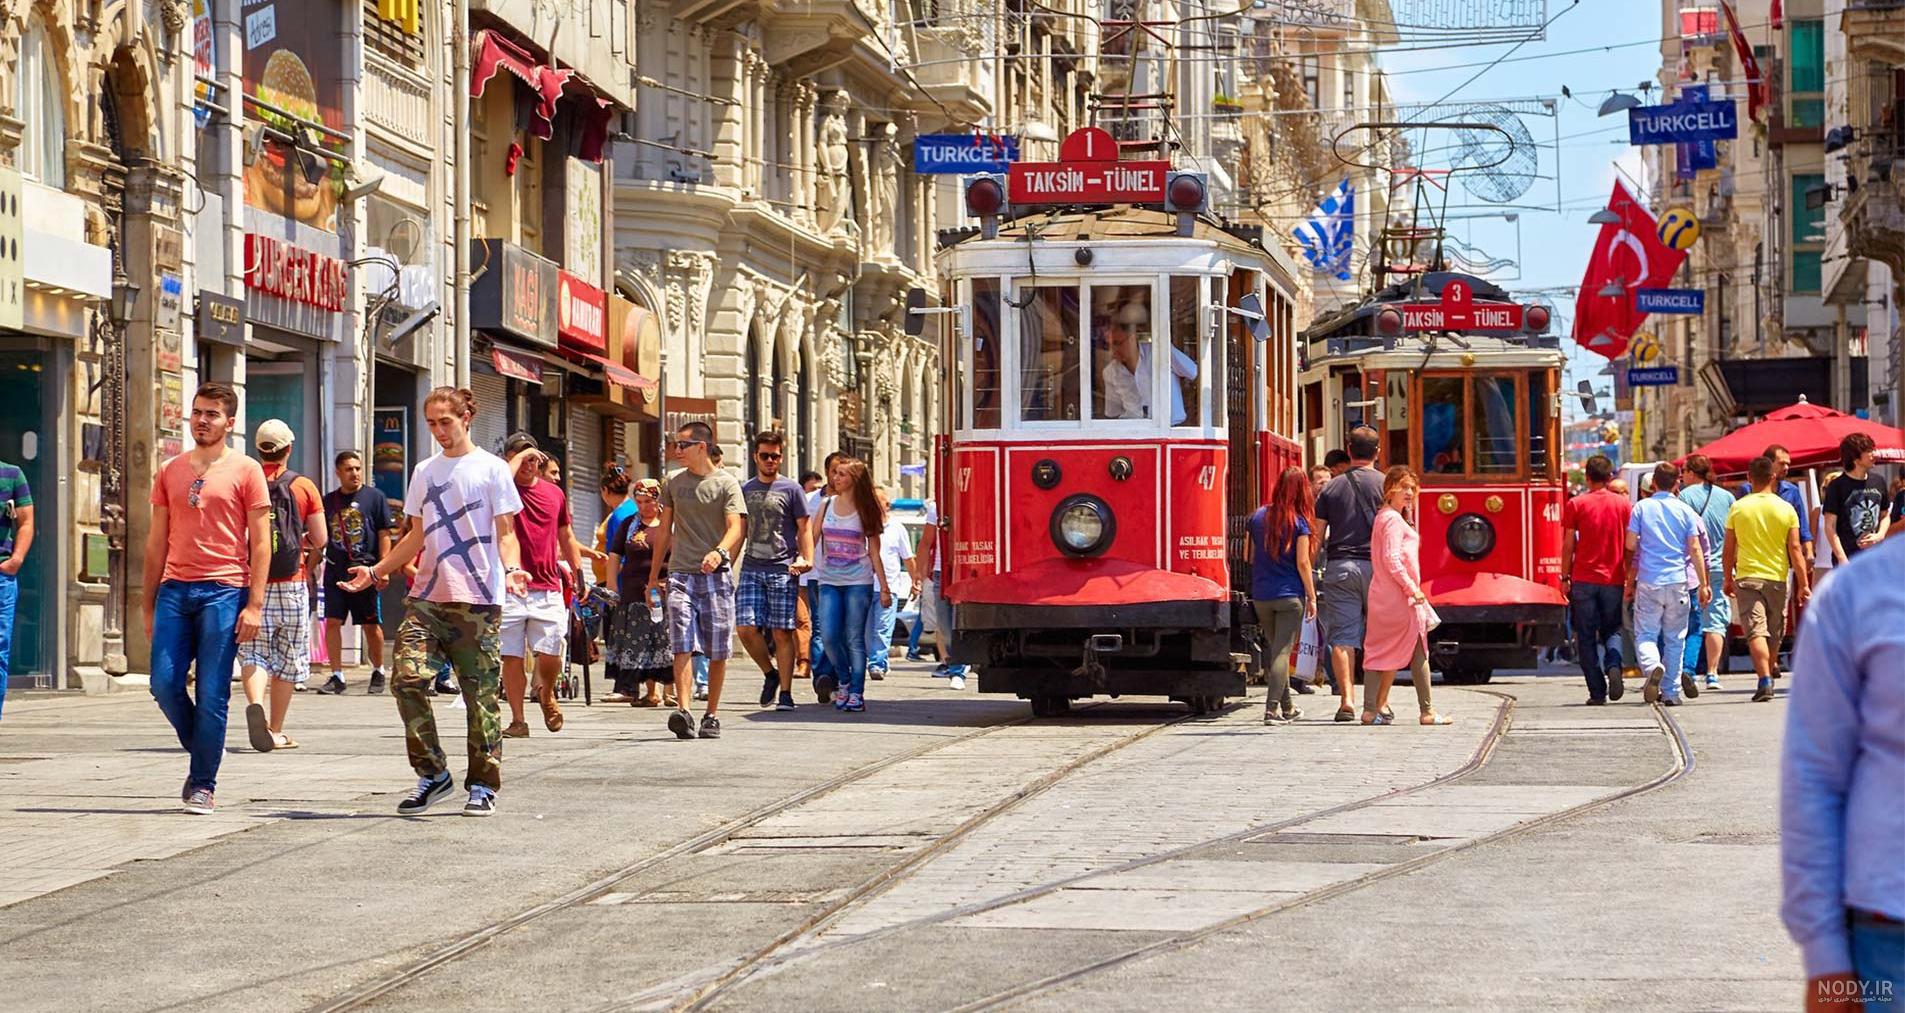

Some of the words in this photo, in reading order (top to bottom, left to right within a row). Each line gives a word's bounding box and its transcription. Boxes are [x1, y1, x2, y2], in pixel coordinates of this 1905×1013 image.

[1635, 112, 1731, 134] TURKCELL
[1086, 131, 1093, 158] 1
[1024, 167, 1084, 193] TAKSİM
[1103, 167, 1161, 192] TÜNEL
[253, 232, 312, 303] BURGER
[313, 251, 347, 312] KING
[1452, 284, 1462, 302] 3
[1640, 294, 1701, 308] TURKCELL
[1403, 308, 1445, 327] TAKSİM
[1473, 308, 1515, 327] TÜNEL
[1631, 371, 1675, 383] TURKCELL
[957, 467, 971, 492] 47
[1198, 465, 1216, 490] 47
[1179, 549, 1189, 560] VE
